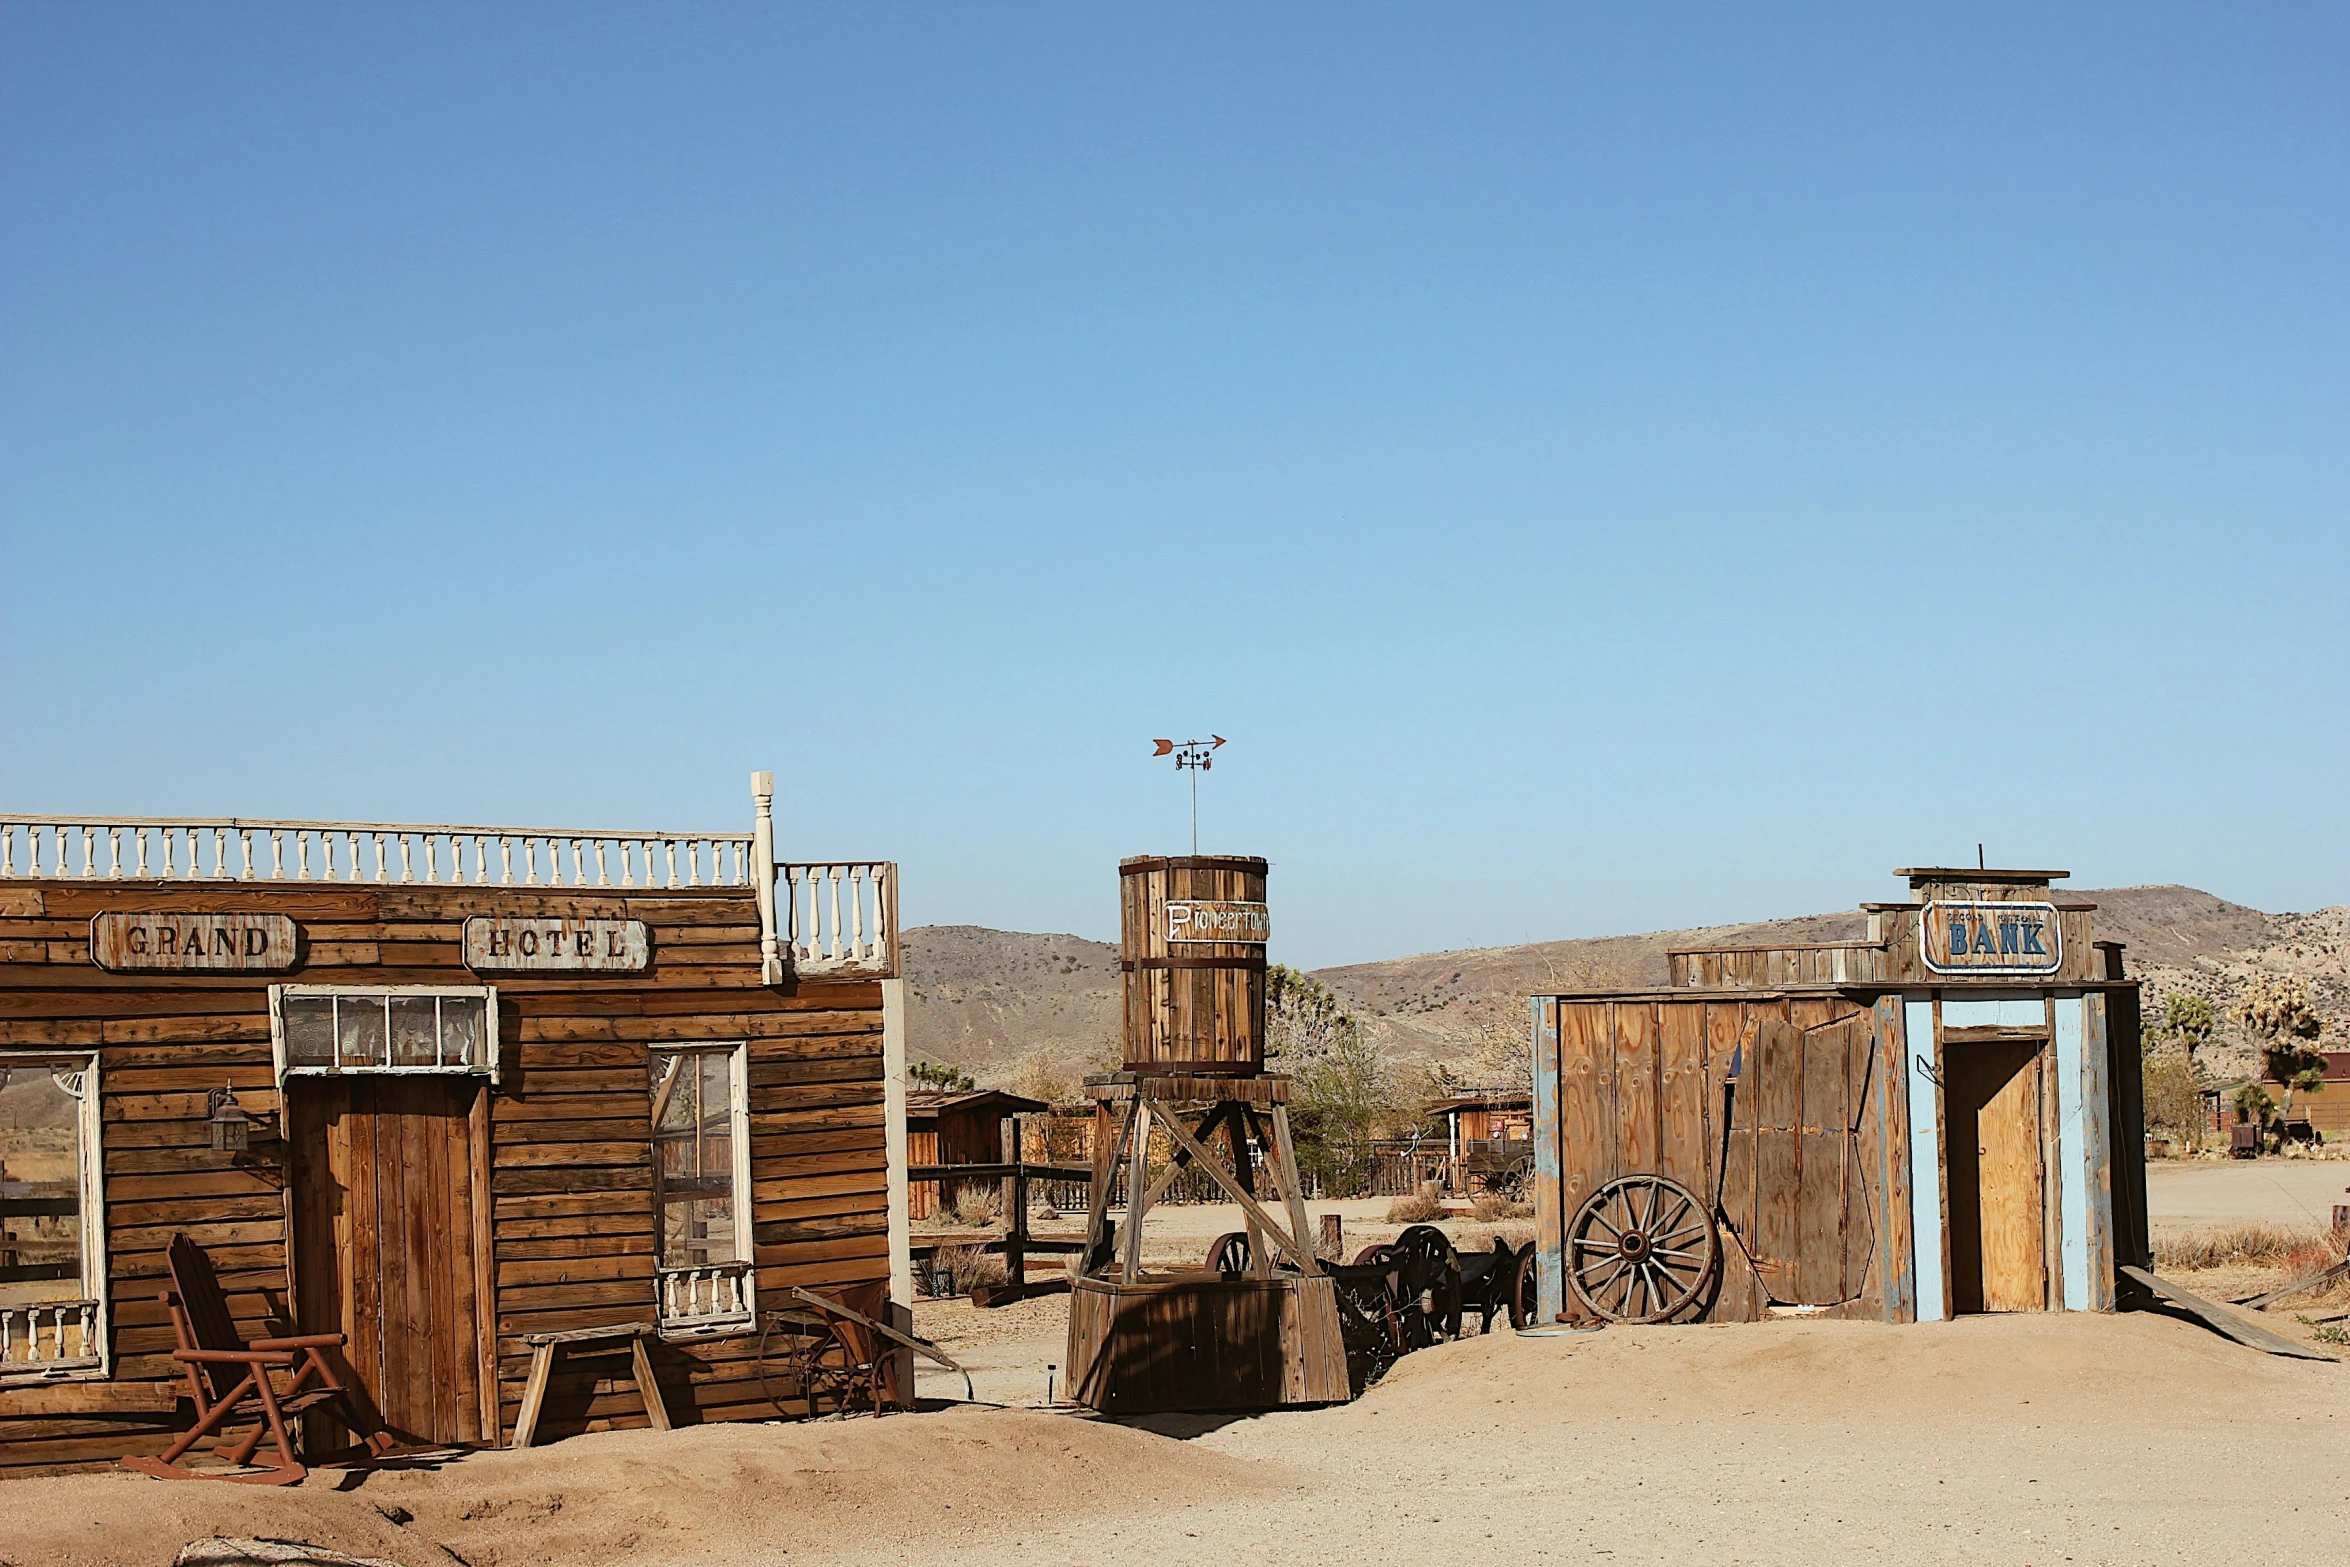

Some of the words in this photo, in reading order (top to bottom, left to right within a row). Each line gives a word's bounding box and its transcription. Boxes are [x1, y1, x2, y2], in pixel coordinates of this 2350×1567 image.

[1168, 906, 1268, 939] Pioneertown
[1946, 913, 1983, 922] SECOND
[127, 926, 269, 956] GRAND
[489, 929, 626, 957] HOTEL
[1950, 923, 2046, 955] BANK
